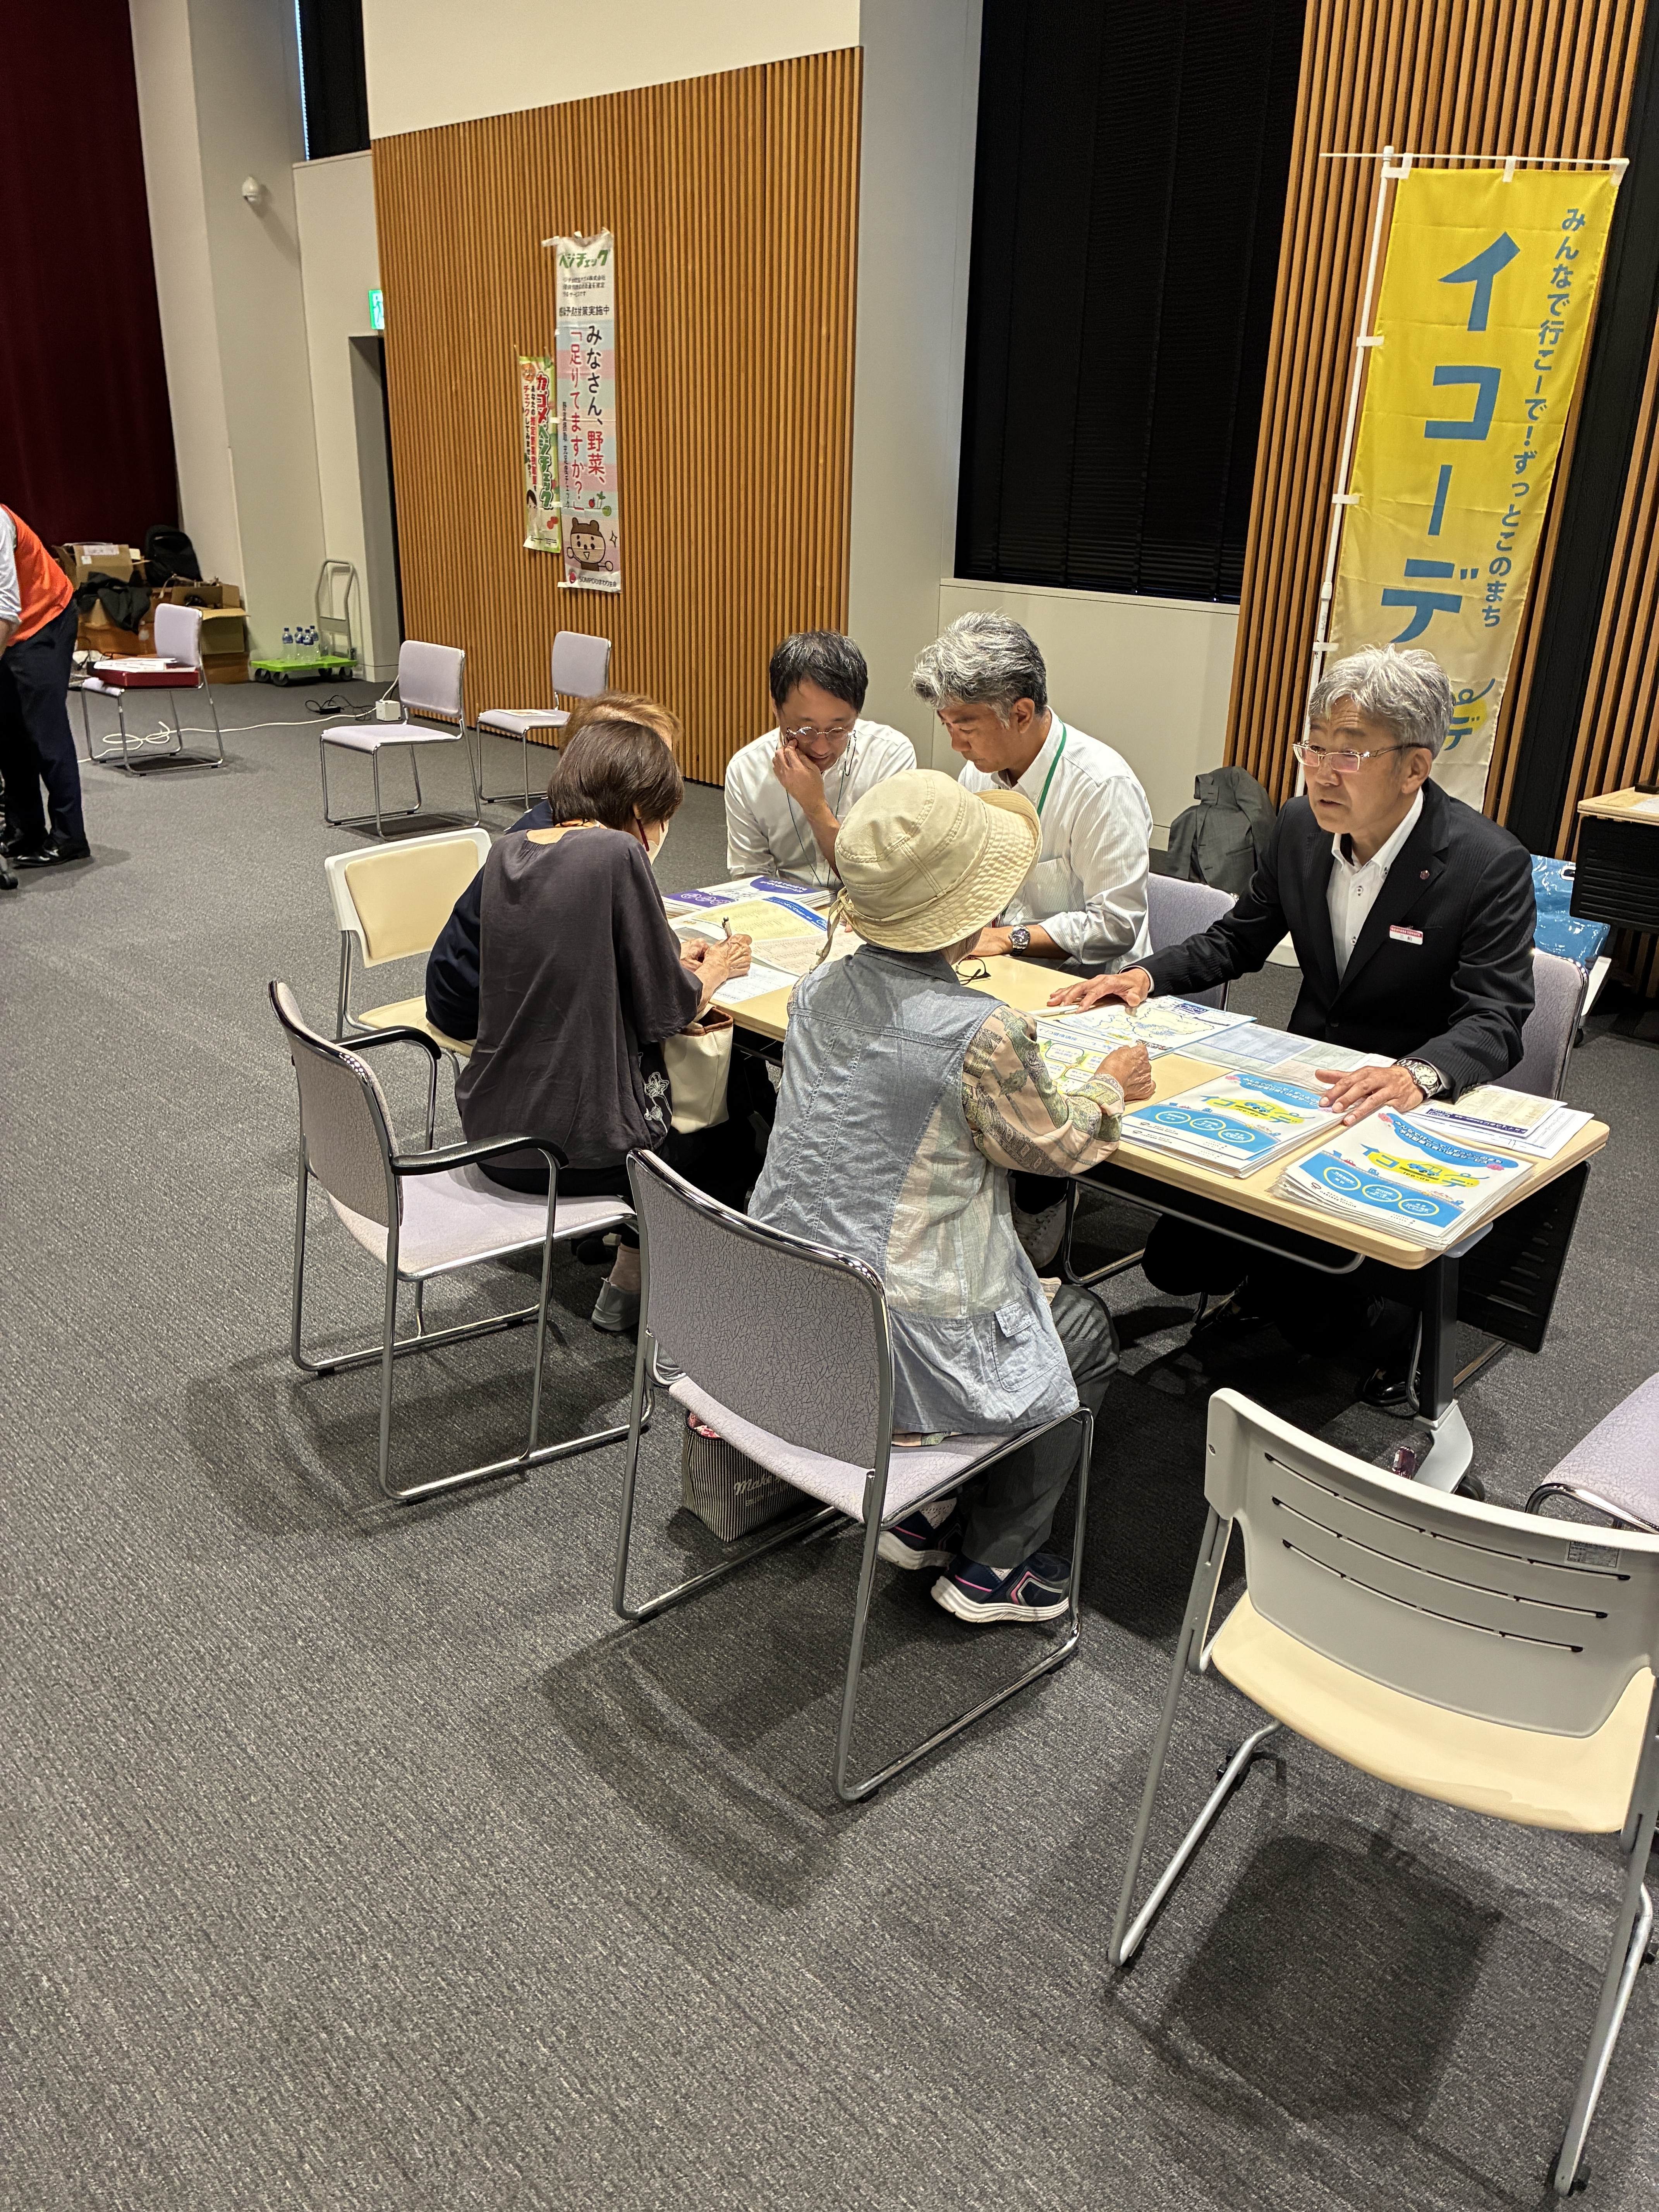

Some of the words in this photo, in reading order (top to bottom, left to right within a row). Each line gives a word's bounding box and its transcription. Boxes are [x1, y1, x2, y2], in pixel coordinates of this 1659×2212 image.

[587, 326, 605, 483] みなさん、野菜、
[1381, 231, 1521, 643] イコーデ
